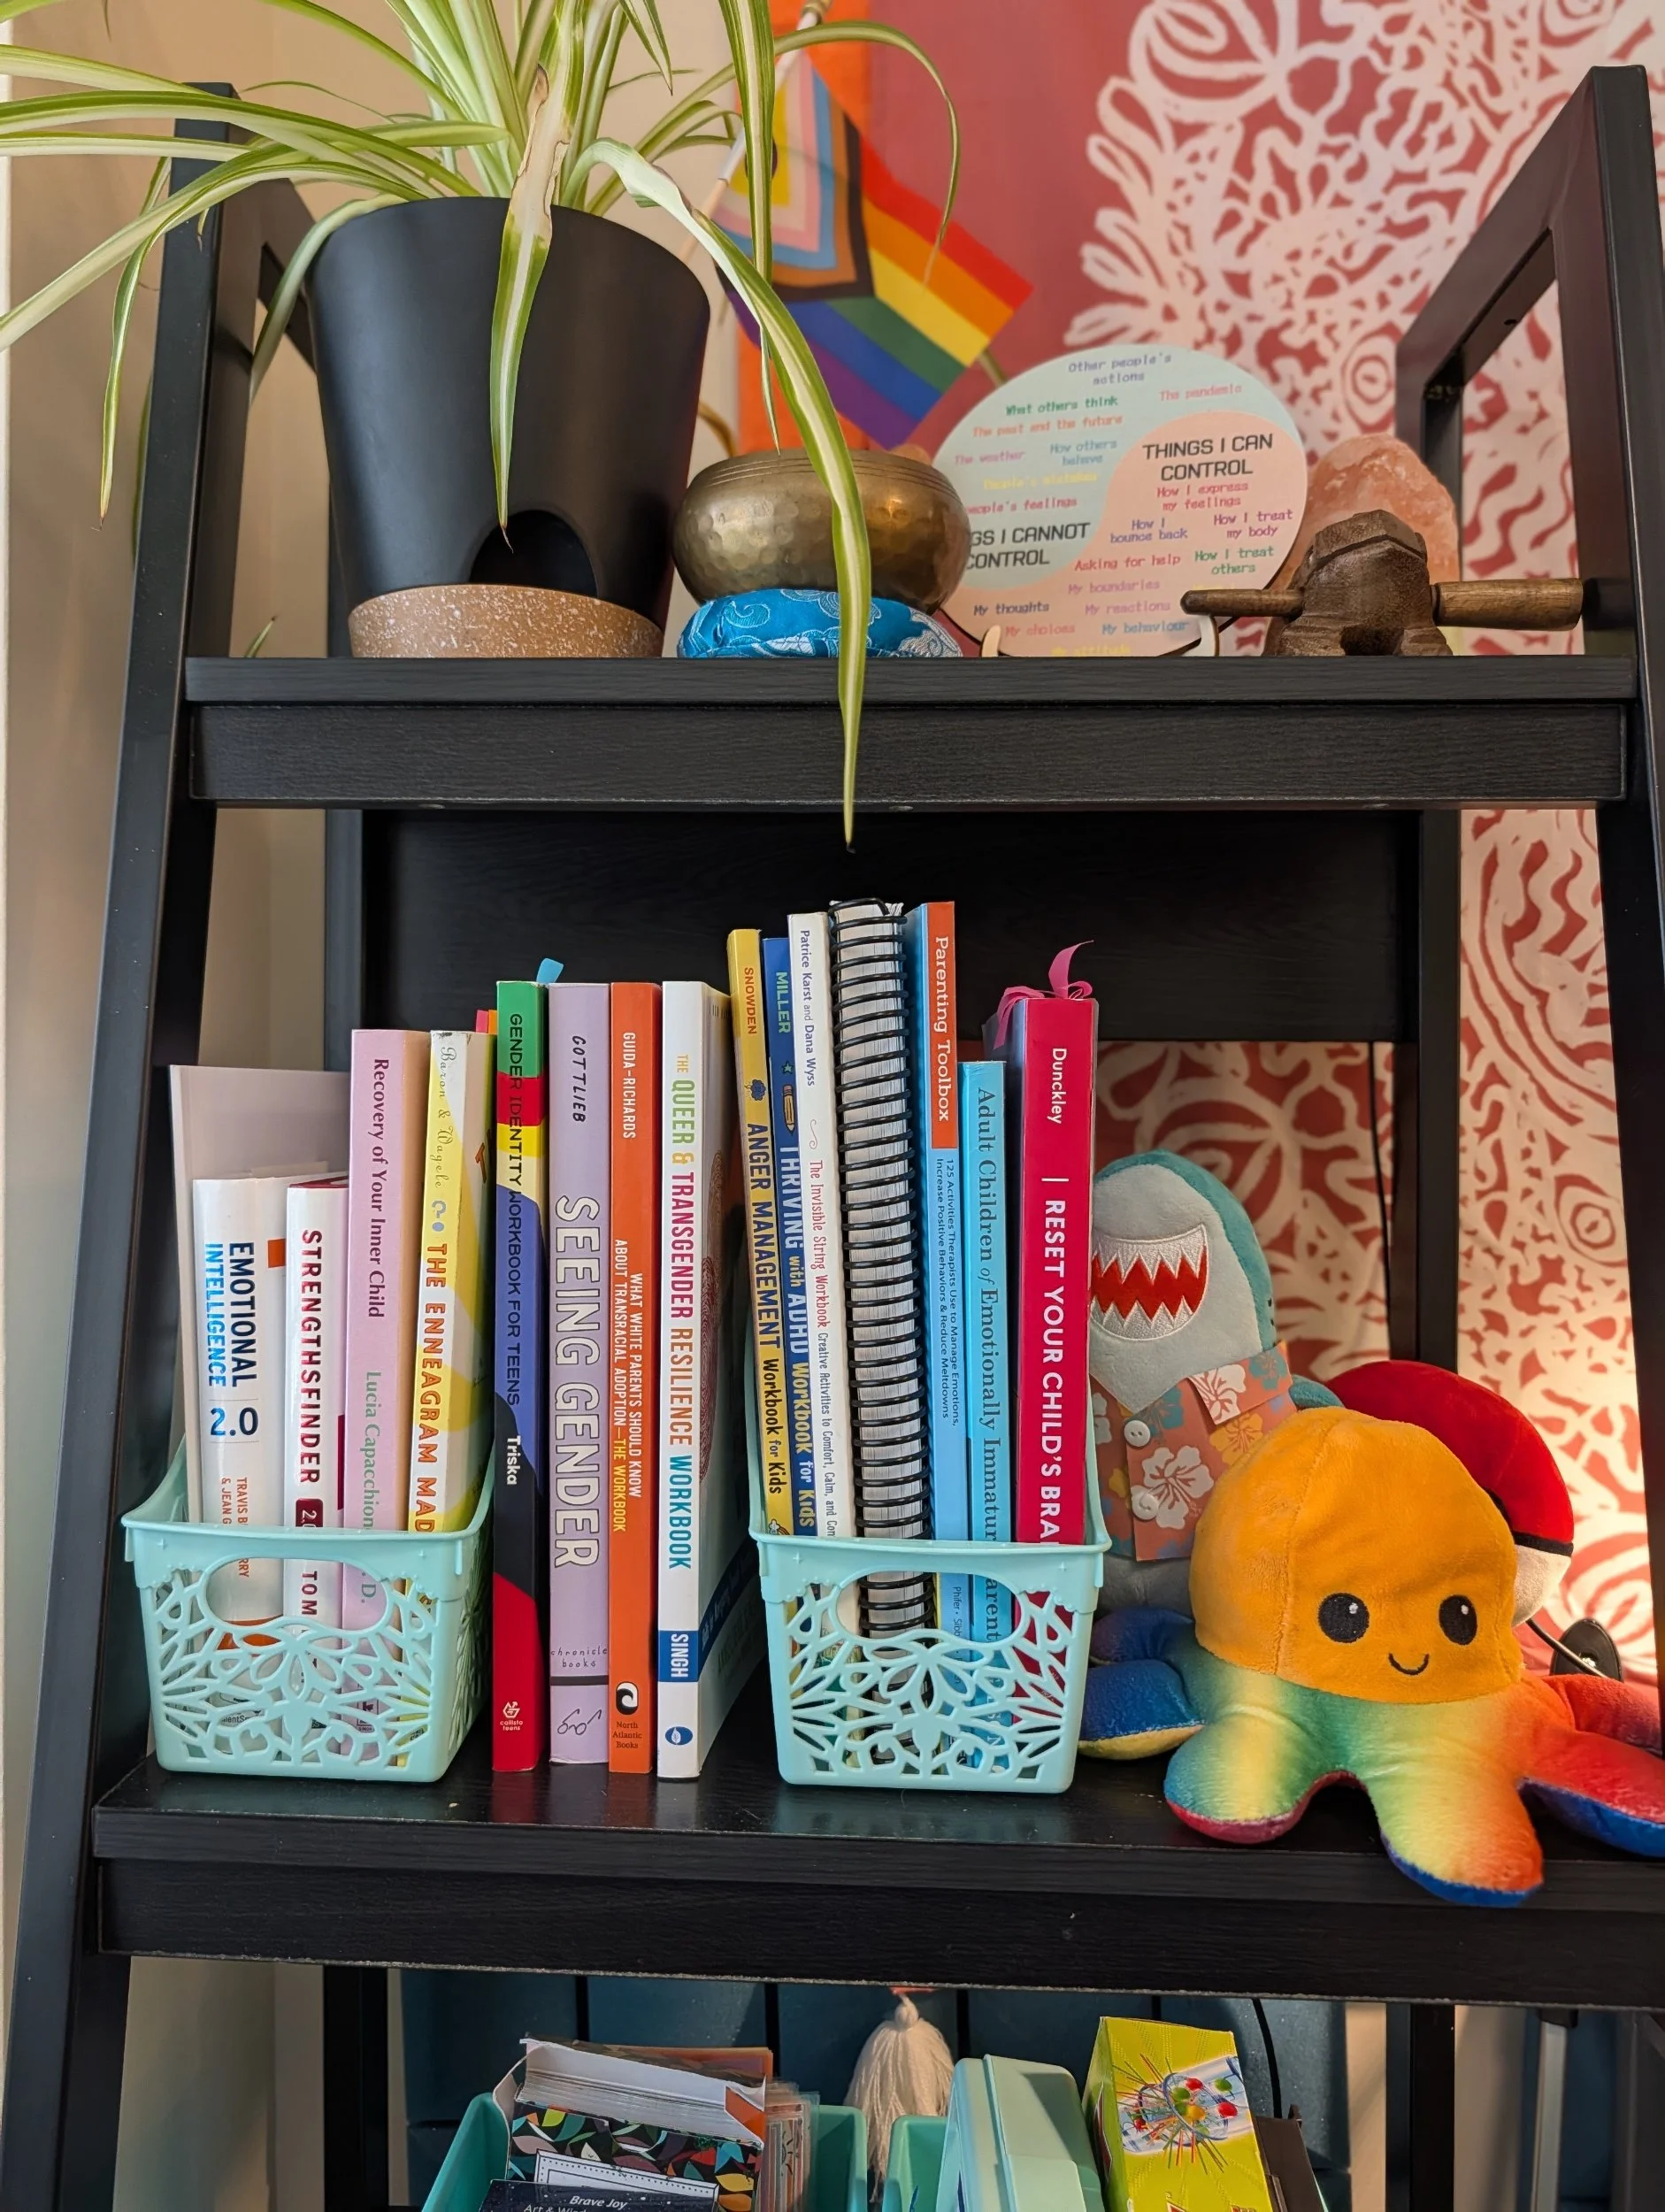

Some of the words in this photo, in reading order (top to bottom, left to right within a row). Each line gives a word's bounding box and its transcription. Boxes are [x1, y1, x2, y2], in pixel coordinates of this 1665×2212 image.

[1069, 361, 1106, 373] Other
[1111, 353, 1172, 371] people's
[1038, 401, 1078, 413] others
[1085, 396, 1118, 408] think
[1159, 391, 1178, 401] The
[1185, 383, 1242, 400] pandemic
[1030, 421, 1050, 433] and
[1057, 419, 1076, 430] the
[1083, 414, 1123, 427] future
[1050, 443, 1071, 454] How
[1076, 440, 1116, 452] others
[1143, 439, 1214, 459] THINGS
[1220, 438, 1225, 453] I
[1231, 434, 1273, 452] CAN
[1157, 488, 1179, 498] How
[1198, 482, 1248, 495] express
[1161, 459, 1254, 481] CONTROL
[1024, 497, 1078, 511] feelings
[1162, 502, 1177, 511] my
[1185, 497, 1241, 511] feelings
[1214, 515, 1236, 526] How
[1256, 509, 1293, 522] treat
[1012, 522, 1091, 544] CANNOT
[1110, 532, 1153, 543] bounce
[1159, 528, 1188, 541] back
[1132, 519, 1154, 531] How
[1227, 529, 1241, 540] my
[1248, 525, 1278, 537] body
[1075, 558, 1117, 572] Asking
[1124, 557, 1146, 569] for
[1152, 554, 1181, 566] help
[1195, 550, 1216, 562] How
[1239, 546, 1274, 558] treat
[1211, 564, 1255, 575] others
[1068, 584, 1083, 595] My
[1090, 580, 1160, 593] boundaries
[973, 604, 988, 616] My
[995, 601, 1050, 614] thoughts
[1085, 604, 1100, 616] My
[1107, 601, 1170, 614] reactions
[1101, 624, 1116, 635] My
[1124, 620, 1189, 634] behaviour
[1026, 624, 1076, 635] choices
[801, 930, 812, 968] Patrice
[744, 967, 757, 1034] SNOWDEN
[776, 972, 791, 1033] MILLER
[802, 972, 812, 1001] Karst
[933, 936, 948, 1033] Parenting
[510, 1013, 523, 1090] GENDER
[804, 1025, 815, 1054] Dana
[440, 1047, 457, 1098] Baron
[572, 1035, 587, 1123] GOTTLIEB
[677, 1054, 688, 1073] THE
[804, 1057, 816, 1087] Wyss
[937, 1041, 952, 1122] Toolbox
[367, 1057, 389, 1140] Recovery
[623, 1032, 636, 1139] GUIDA-RICHARDS
[1047, 1048, 1067, 1125] Dunckley
[671, 1079, 695, 1145] QUEER
[978, 1087, 996, 1152] Adult
[370, 1146, 387, 1165] of
[509, 1094, 522, 1185] IDENTITY
[672, 1153, 694, 1164] &
[747, 1123, 770, 1191] ANGER
[809, 1160, 824, 1179] The
[371, 1171, 387, 1212] Your
[780, 1147, 803, 1249] THRIVING
[811, 1183, 825, 1230] Invisible
[978, 1159, 998, 1262] Children
[370, 1217, 386, 1265] Inner
[508, 1187, 522, 1294] WORKBOOK
[614, 1239, 627, 1277] ABOUT
[671, 1171, 694, 1319] TRANSGENDER
[810, 1236, 826, 1270] String
[1045, 1199, 1065, 1278] RESET
[426, 1243, 447, 1288] THE
[751, 1201, 780, 1349] MANAGEMENT
[789, 1256, 805, 1287] with
[938, 1249, 947, 1302] Behaviors
[947, 1233, 956, 1286] Therapists
[978, 1267, 995, 1285] of
[368, 1271, 386, 1317] Child
[555, 1195, 601, 1366] SEEING
[629, 1273, 643, 1308] WHAT
[204, 1243, 226, 1388] INTELLIGENCE
[228, 1241, 259, 1388] EMOTIONAL
[508, 1301, 521, 1336] FOR
[816, 1274, 831, 1328] Workbook
[950, 1311, 956, 1324] to
[614, 1282, 627, 1363] TRANSRACIAL
[629, 1312, 643, 1350] WHITE
[940, 1315, 948, 1356] Reduce
[1041, 1286, 1064, 1363] YOUR
[300, 1230, 322, 1484] STRENGTHSFINDER
[817, 1333, 829, 1369] Creative
[949, 1326, 958, 1370] Manage
[979, 1288, 1001, 1430] Emotionally
[418, 1302, 446, 1463] ENNEAGRAM
[506, 1342, 520, 1406] TEENS
[629, 1355, 642, 1407] PARENTS
[670, 1329, 694, 1445] RESILIENCE
[819, 1372, 831, 1415] Activities
[365, 1371, 382, 1420] Lucia
[763, 1358, 783, 1435] Workbook
[792, 1362, 813, 1455] Workbook
[210, 1405, 259, 1437] 2.0
[629, 1411, 642, 1456] SHOULD
[1040, 1371, 1063, 1478] CHILD'S
[506, 1435, 522, 1486] Triska
[769, 1438, 782, 1458] for
[823, 1431, 834, 1469] Comfort,
[555, 1382, 601, 1569] GENDER
[629, 1461, 642, 1498] KNOW
[768, 1462, 787, 1494] Kids
[799, 1460, 812, 1483] for
[824, 1471, 835, 1496] Calm,
[983, 1437, 1001, 1541] Immatur
[221, 1489, 232, 1514] JEAN
[236, 1477, 249, 1514] TRAVIS
[414, 1477, 438, 1532] MAD
[613, 1465, 626, 1532] WORKBOOK
[669, 1455, 693, 1570] WORKBOOK
[798, 1489, 817, 1528] Kids
[825, 1501, 837, 1517] and
[1040, 1486, 1061, 1545] BRA
[301, 1571, 318, 1616] TOM
[953, 1586, 962, 1609] Phifer
[550, 1645, 609, 1656] chronicle
[562, 1658, 596, 1668] books
[671, 1633, 689, 1678] SINGH
[616, 1740, 639, 1749] Books
[569, 2195, 605, 2208] Brave
[606, 2199, 628, 2211] Joy
